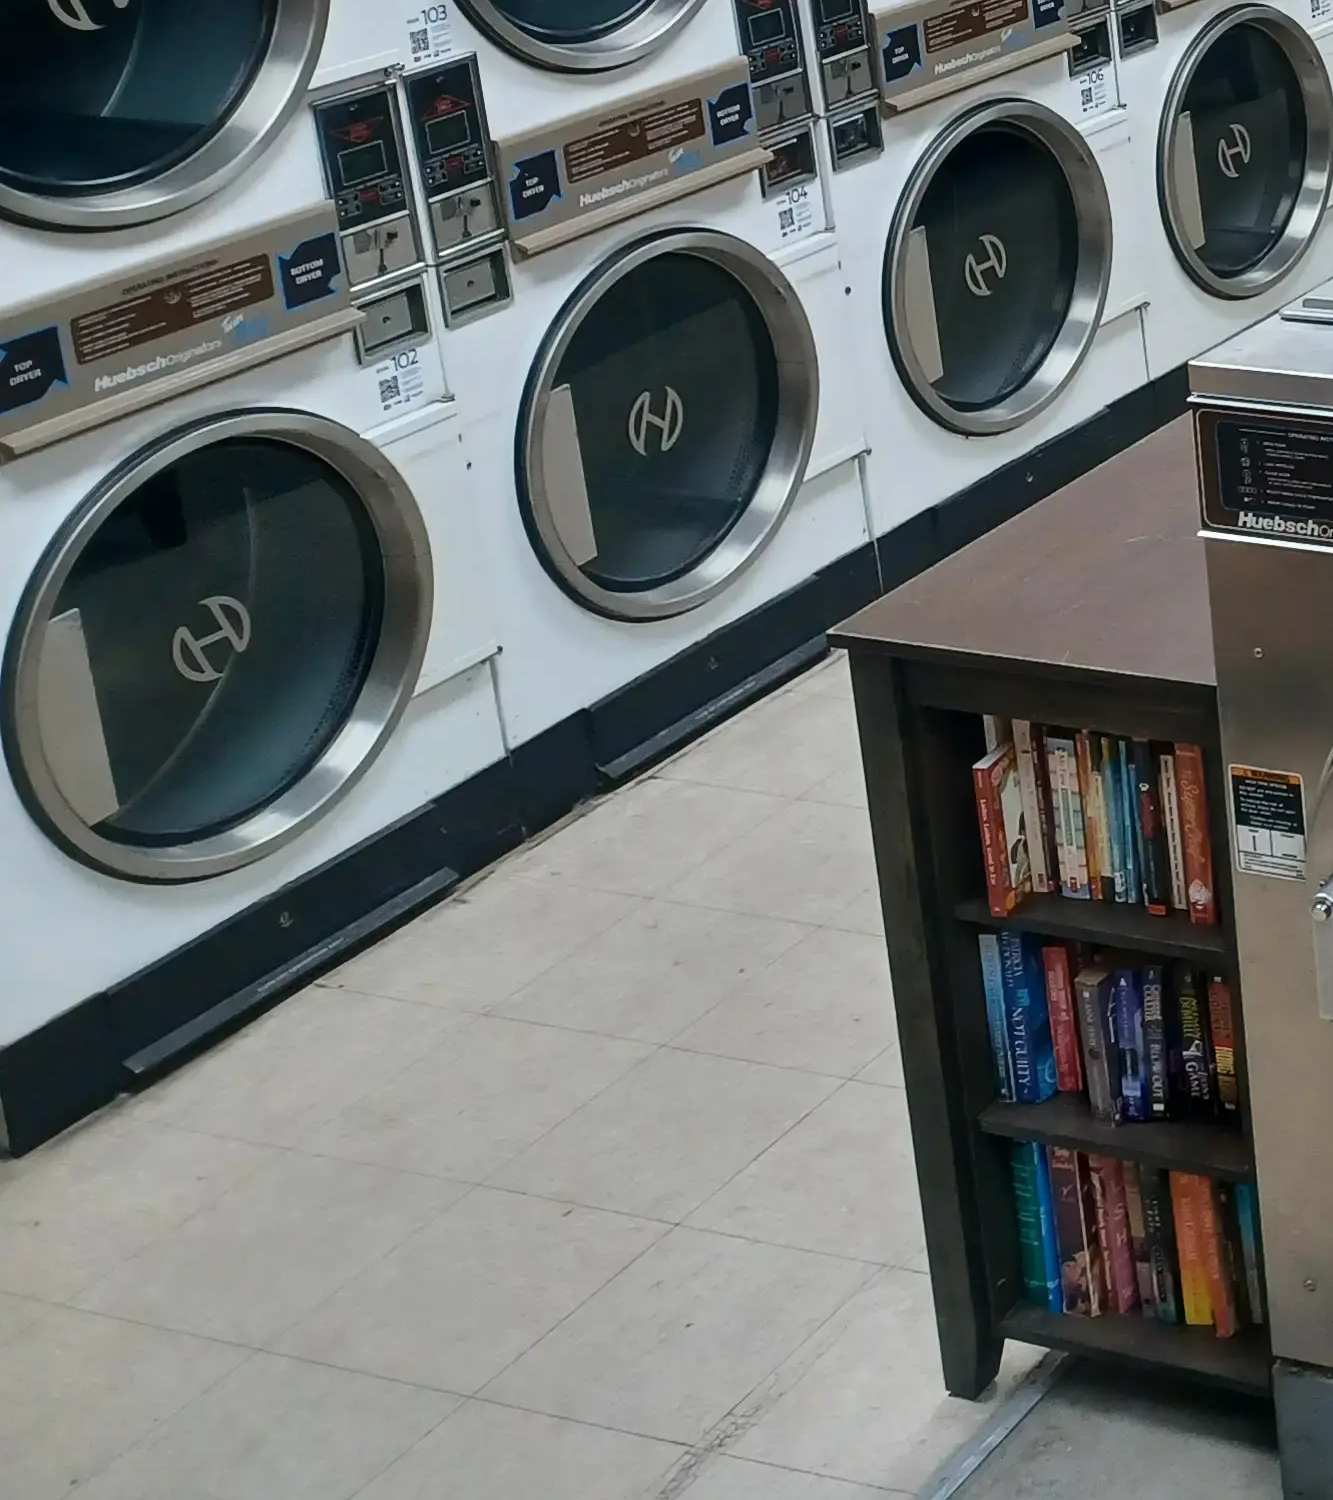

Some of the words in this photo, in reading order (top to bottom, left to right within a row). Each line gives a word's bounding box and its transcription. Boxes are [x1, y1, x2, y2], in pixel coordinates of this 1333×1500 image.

[420, 4, 448, 26] 103
[891, 53, 909, 64] DRYER
[894, 46, 905, 55] TOP
[1086, 68, 1104, 84] 106
[716, 104, 741, 118] BOTTOM
[720, 113, 740, 126] DRYER
[525, 177, 540, 187] TOP
[522, 185, 545, 199] DRYER
[785, 185, 808, 205] 104
[290, 258, 324, 276] BOTTOM
[295, 269, 323, 285] DRYER
[14, 360, 33, 372] TOP
[390, 348, 419, 372] 102
[9, 368, 42, 387] DRYER
[1009, 1006, 1027, 1038] NOT
[1014, 1039, 1034, 1088] GUILTY
[1214, 1045, 1236, 1076] HONG
[1151, 1074, 1165, 1100] OUT
[1184, 1060, 1201, 1099] GAME
